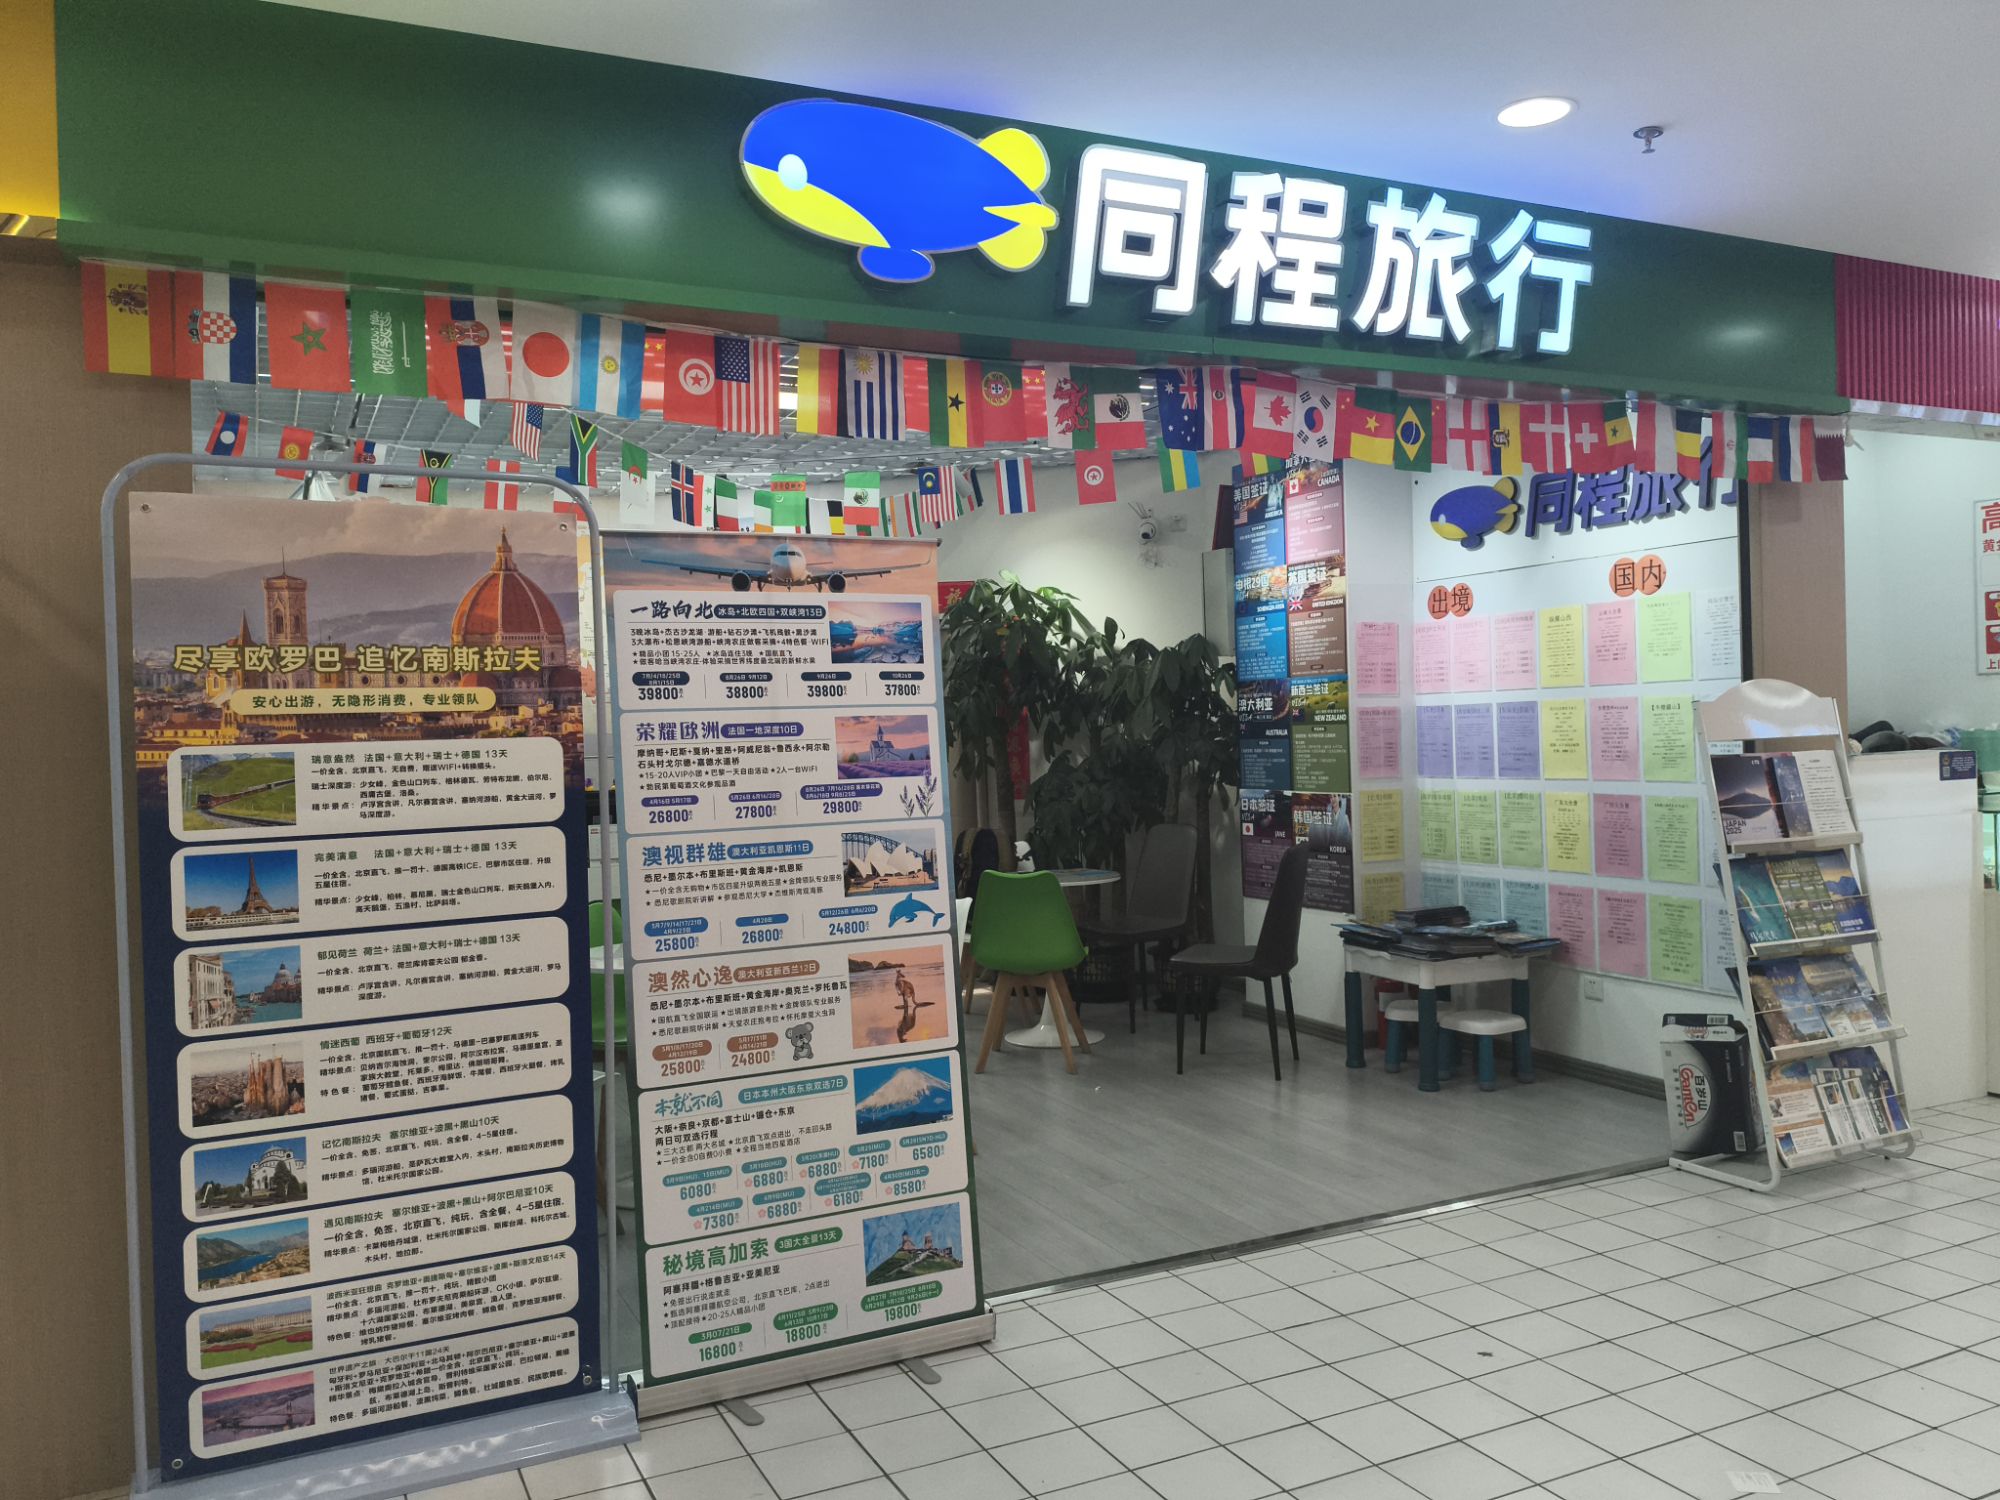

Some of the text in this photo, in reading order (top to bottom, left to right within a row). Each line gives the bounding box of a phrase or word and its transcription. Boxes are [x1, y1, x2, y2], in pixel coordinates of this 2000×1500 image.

[1066, 143, 1595, 356] 同程旅行
[1234, 482, 1268, 501] 美国签证
[1288, 567, 1326, 585] 英国签证
[1613, 561, 1663, 593] 国内
[1431, 585, 1472, 614] 出境
[630, 600, 714, 620] 一路向北
[718, 607, 823, 617] 冰岛+北欧四国+双峡湾13日
[174, 646, 540, 672] 尽享欧罗巴 追忆南斯拉夫
[765, 649, 792, 657] 国航直飞
[638, 687, 678, 700] 39800
[726, 686, 763, 698] 38800
[807, 685, 843, 697] 39800
[885, 684, 917, 696] 37800
[1291, 684, 1328, 695] 新西兰签证
[252, 694, 479, 708] 安心出游，无隐形消费，专业领队
[1239, 698, 1273, 711] 澳大利亚
[636, 721, 719, 741] 荣耀欧洲
[728, 726, 797, 735] 法国一地深度10日
[311, 749, 508, 764] 瑞意盎然 法国+意大利+瑞士+德国 13天
[711, 767, 769, 776] 巴黎一天自由活动
[735, 805, 773, 819] 27800
[823, 801, 859, 813] 29800
[1242, 799, 1275, 812] 日本签证
[649, 810, 688, 823] 26800
[1294, 811, 1332, 824] 韩国签证
[374, 843, 490, 859] 法国+意大利+瑞士+德国
[494, 841, 517, 850] 13天
[642, 842, 727, 866] 澳视群雄
[731, 844, 810, 857] 澳大利亚凯恩斯11日
[644, 863, 803, 882] 悉尼+墨尔本+布里斯班+黄金海岸+凯恩斯
[742, 929, 779, 944] 26800
[829, 922, 865, 935] 24800
[318, 948, 357, 960] 郁见荷兰
[392, 935, 497, 953] 法国+意大利+瑞士+德国
[500, 933, 521, 943] 13天
[655, 939, 695, 952] 25800
[648, 965, 734, 993] 澳然心逸
[785, 997, 841, 1010] 金牌领队专业服务
[366, 1026, 452, 1045] 西班牙+葡萄牙12天
[658, 1022, 719, 1037] 悉尼歌剧院听讲解
[731, 1051, 770, 1068] 24800
[660, 1060, 700, 1077] 25800
[743, 1078, 844, 1101] 日本本州大阪东京双选7日
[1680, 1067, 1697, 1122] Ganten
[1695, 1076, 1708, 1110] 百岁山
[655, 1091, 723, 1117] 本就不同
[655, 1106, 796, 1135] 大阪+奈良+京都+富士山+镰仓+东京
[322, 1116, 499, 1149] 记忆南斯拉夫 塞尔维亚+波黑+黑山10天
[656, 1129, 718, 1147] 两日可双选行程
[742, 1137, 801, 1154] 全程当地四星酒店
[913, 1146, 940, 1160] 6580
[808, 1162, 838, 1177] 6880
[860, 1154, 885, 1170] 7180
[753, 1171, 784, 1187] 6880
[893, 1179, 922, 1196] 8580
[680, 1183, 712, 1200] 6080
[833, 1191, 860, 1207] 6180
[324, 1184, 554, 1228] 遇见南斯拉夫 塞尔维亚+波黑+黑山+阿尔巴尼亚10天
[767, 1202, 797, 1218] 6880
[703, 1213, 734, 1230] 7380
[663, 1239, 770, 1276] 秘境高加索
[663, 1265, 780, 1295] 阿塞拜疆+格鲁吉亚+亚美尼亚
[327, 1284, 382, 1300] 波西米亚狂想曲
[670, 1288, 731, 1307] 免签出行说走就走
[884, 1305, 917, 1322] 19800
[785, 1324, 821, 1344] 18800
[699, 1342, 737, 1362] 16800
